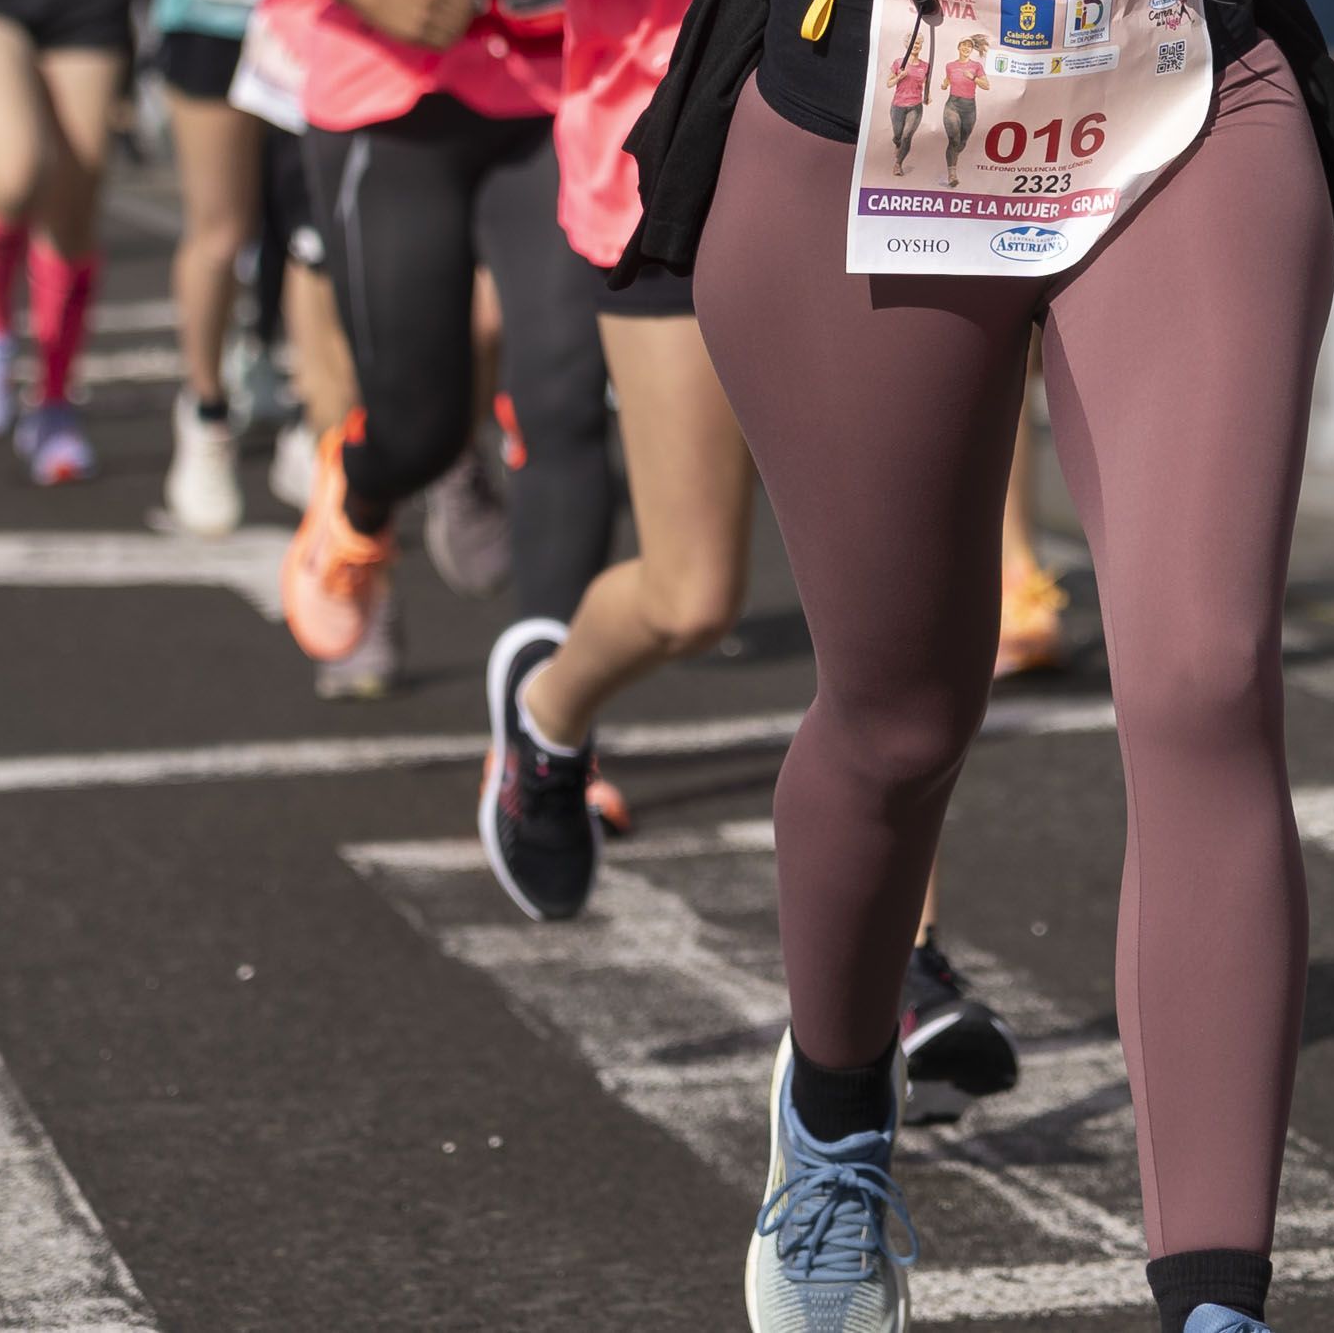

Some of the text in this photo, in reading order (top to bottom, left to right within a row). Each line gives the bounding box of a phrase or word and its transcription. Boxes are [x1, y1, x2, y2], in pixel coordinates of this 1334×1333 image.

[1003, 36, 1020, 45] Gran
[1007, 31, 1045, 40] Cabildo de
[984, 112, 1107, 164] 016
[1012, 173, 1071, 193] 2323
[868, 194, 1115, 218] CARRERA DE LA MUJER GRAN
[887, 239, 950, 253] OYSHO
